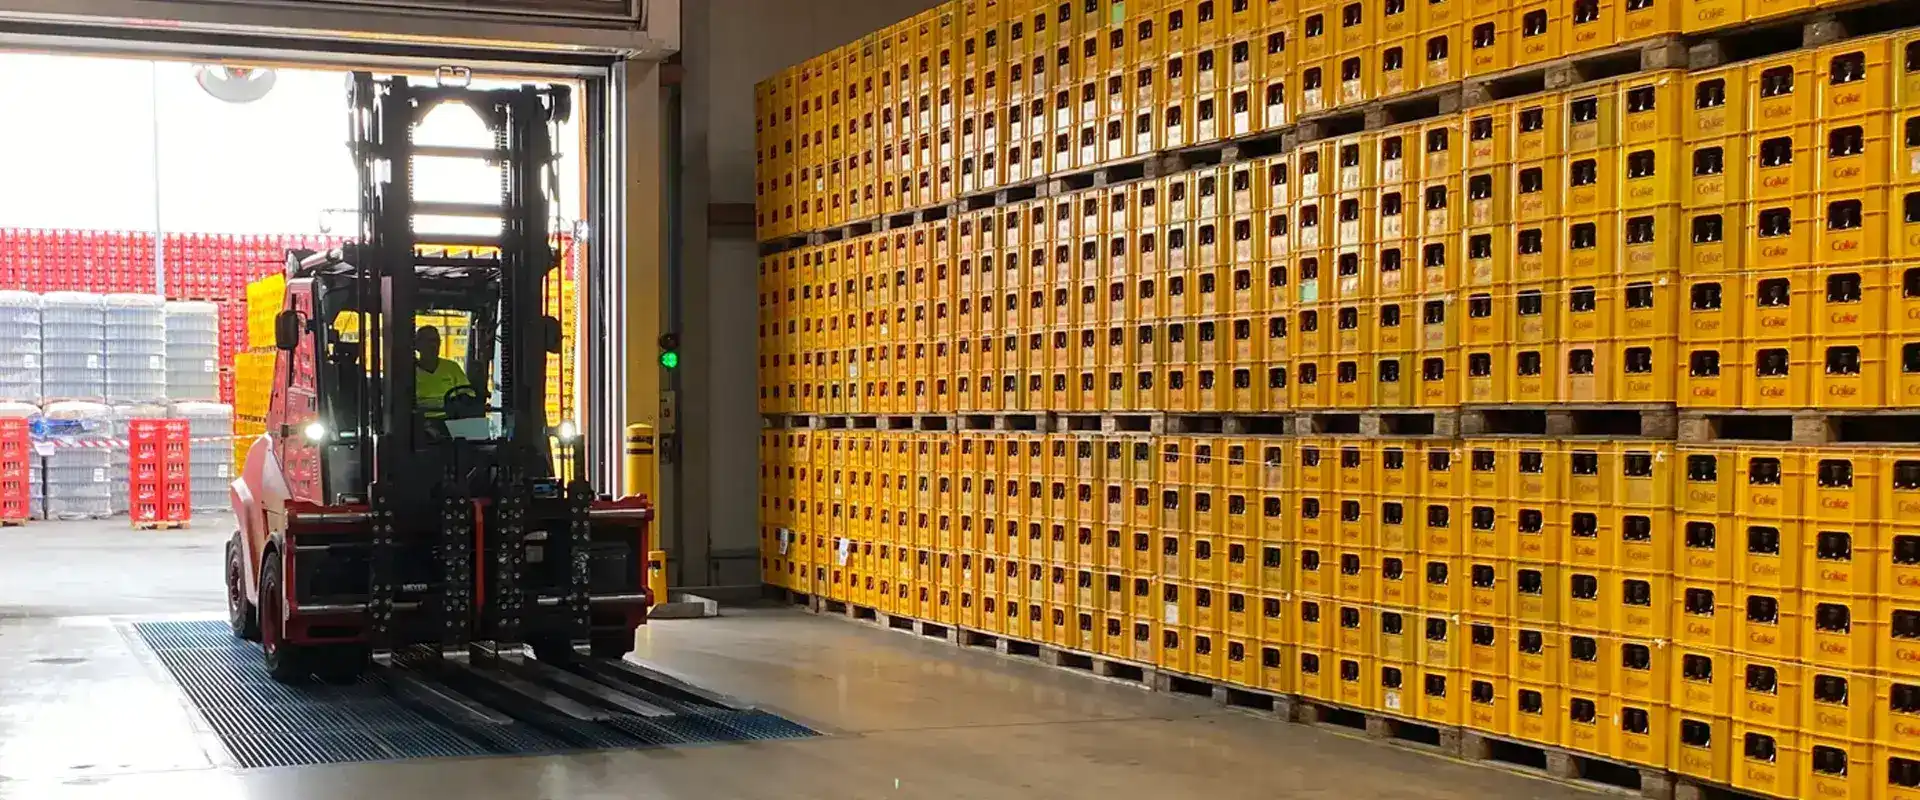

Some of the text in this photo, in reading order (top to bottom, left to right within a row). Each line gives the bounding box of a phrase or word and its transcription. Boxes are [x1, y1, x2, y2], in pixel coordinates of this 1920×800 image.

[1698, 8, 1725, 21] Coke
[1763, 176, 1789, 188] Coke
[1762, 246, 1788, 257] Coke
[1831, 240, 1858, 251] Coke
[1761, 316, 1787, 327] Coke
[1830, 312, 1858, 324] Coke
[1693, 386, 1716, 397] Coke
[1760, 386, 1785, 397] Coke
[1830, 385, 1857, 397] Coke
[1752, 494, 1777, 506] Coke
[1822, 498, 1849, 510] Coke
